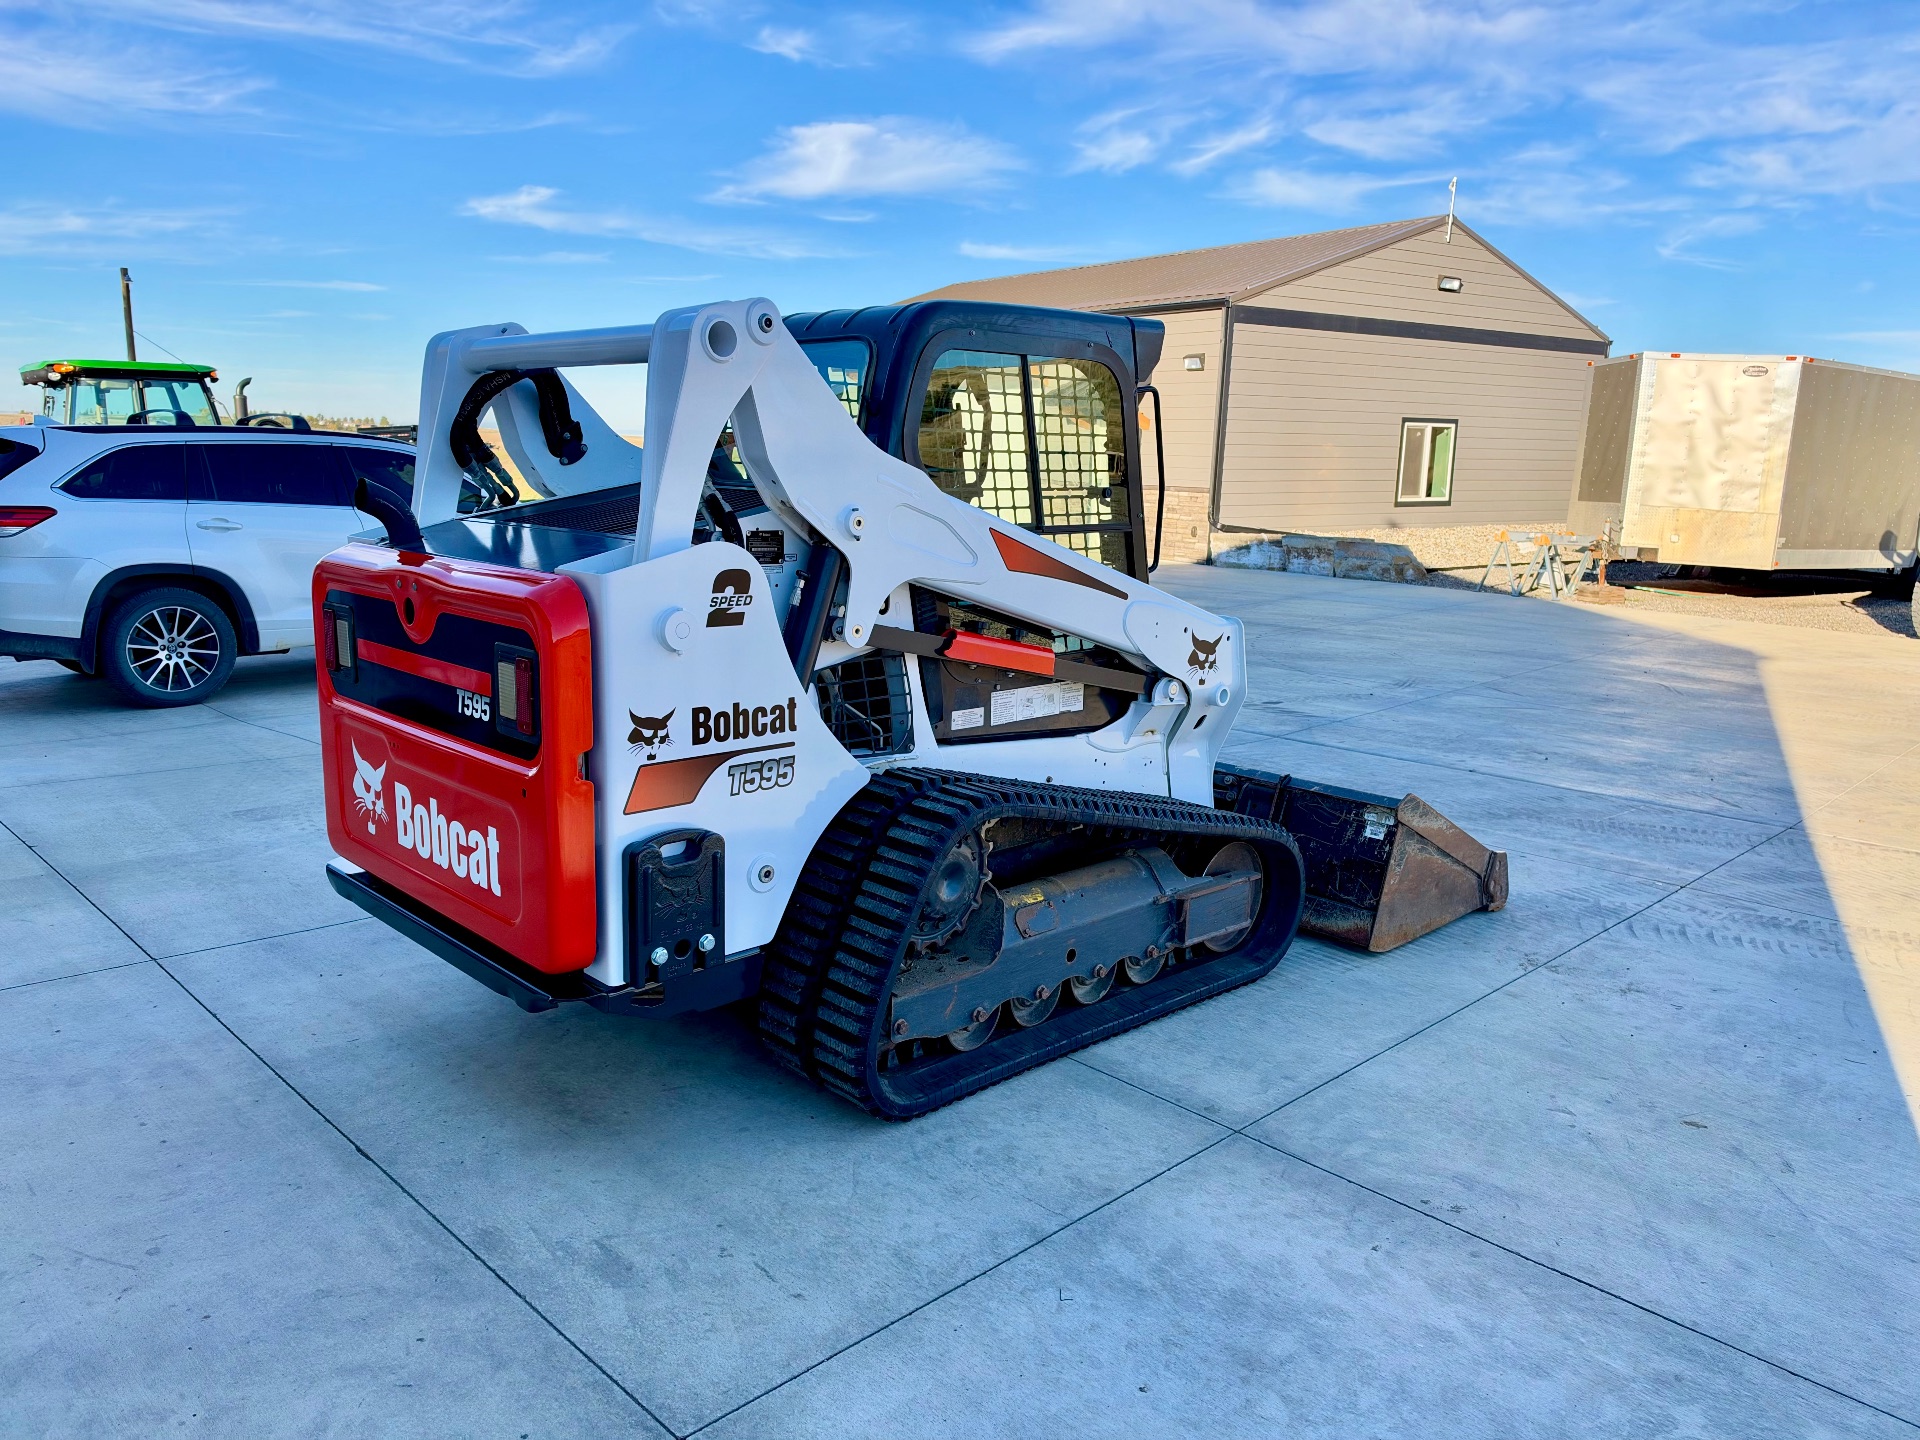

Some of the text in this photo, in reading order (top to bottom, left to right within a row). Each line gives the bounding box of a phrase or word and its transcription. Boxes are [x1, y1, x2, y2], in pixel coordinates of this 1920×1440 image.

[483, 372, 511, 391] MSHA
[706, 568, 751, 628] 2
[709, 595, 753, 607] SPEED
[456, 688, 491, 722] T595
[691, 696, 797, 746] Bobcat
[727, 755, 796, 797] T595
[394, 781, 501, 897] Bobcat
